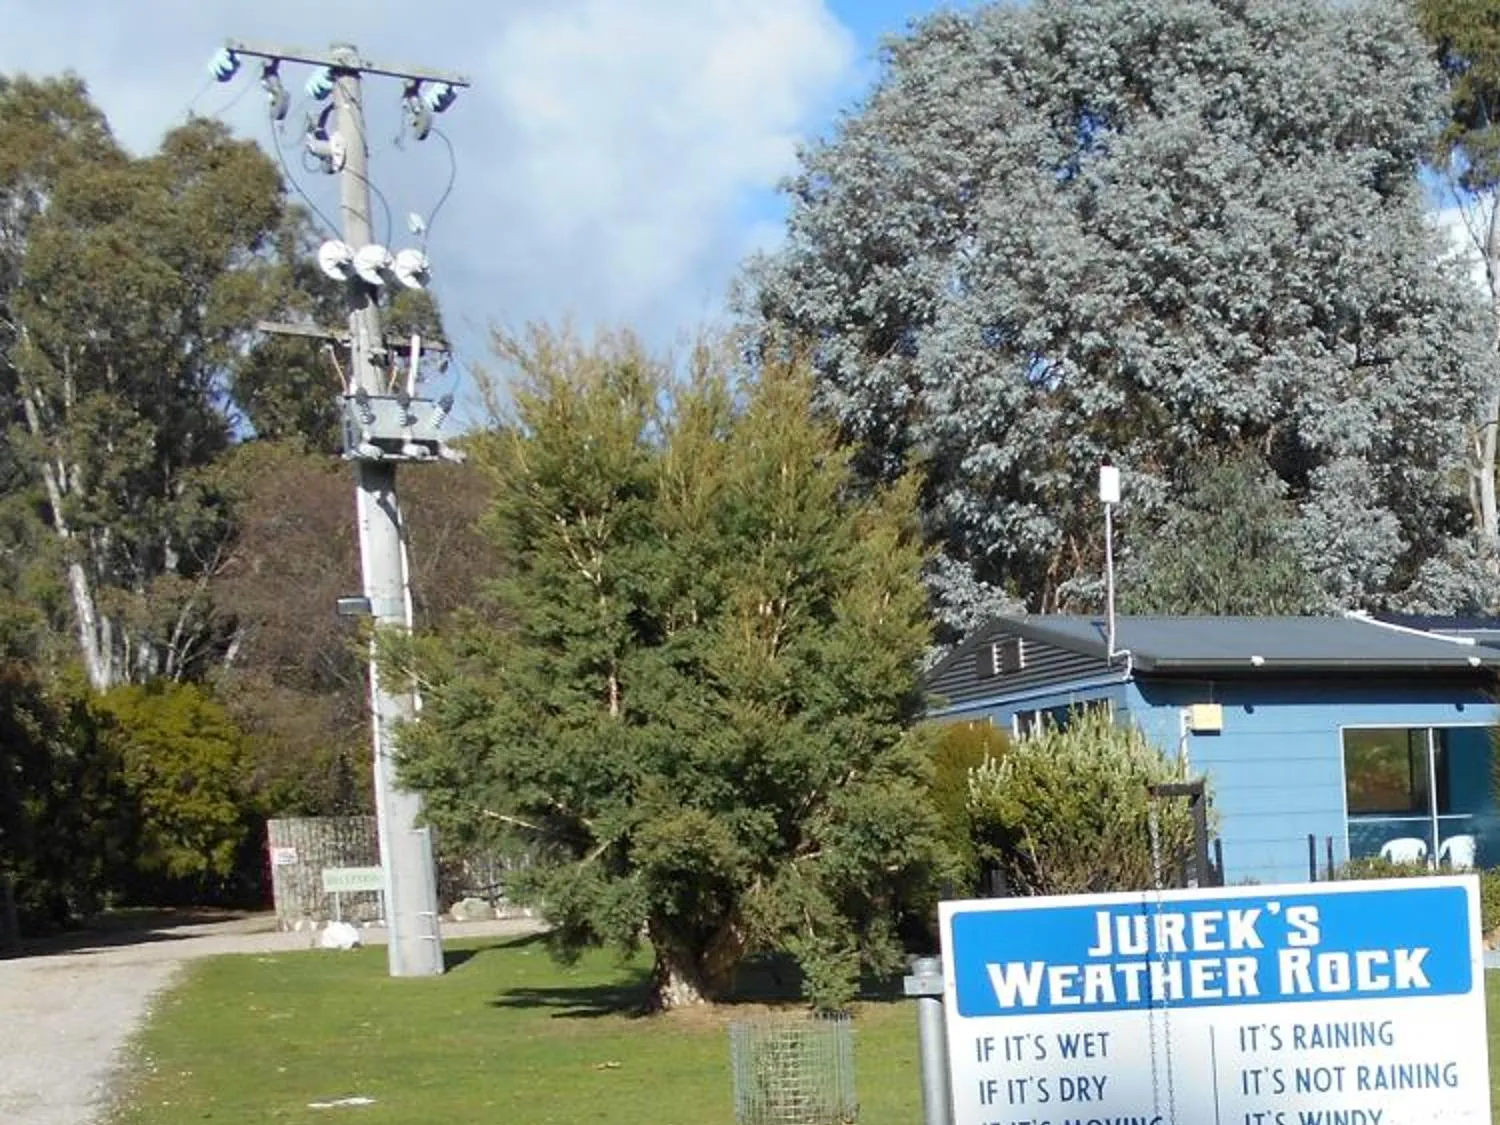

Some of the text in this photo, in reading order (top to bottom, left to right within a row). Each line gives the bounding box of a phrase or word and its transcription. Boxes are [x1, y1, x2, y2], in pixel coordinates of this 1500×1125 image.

[1089, 901, 1321, 957] JUREK'S
[986, 946, 1431, 1008] WEATHER ROCK
[975, 1031, 1110, 1063] IF IT'S WET
[1239, 1020, 1394, 1053] IT'S RAINING
[978, 1074, 1108, 1106] IF IT'S DRY
[1241, 1061, 1458, 1097] IT'S NOT RAINING
